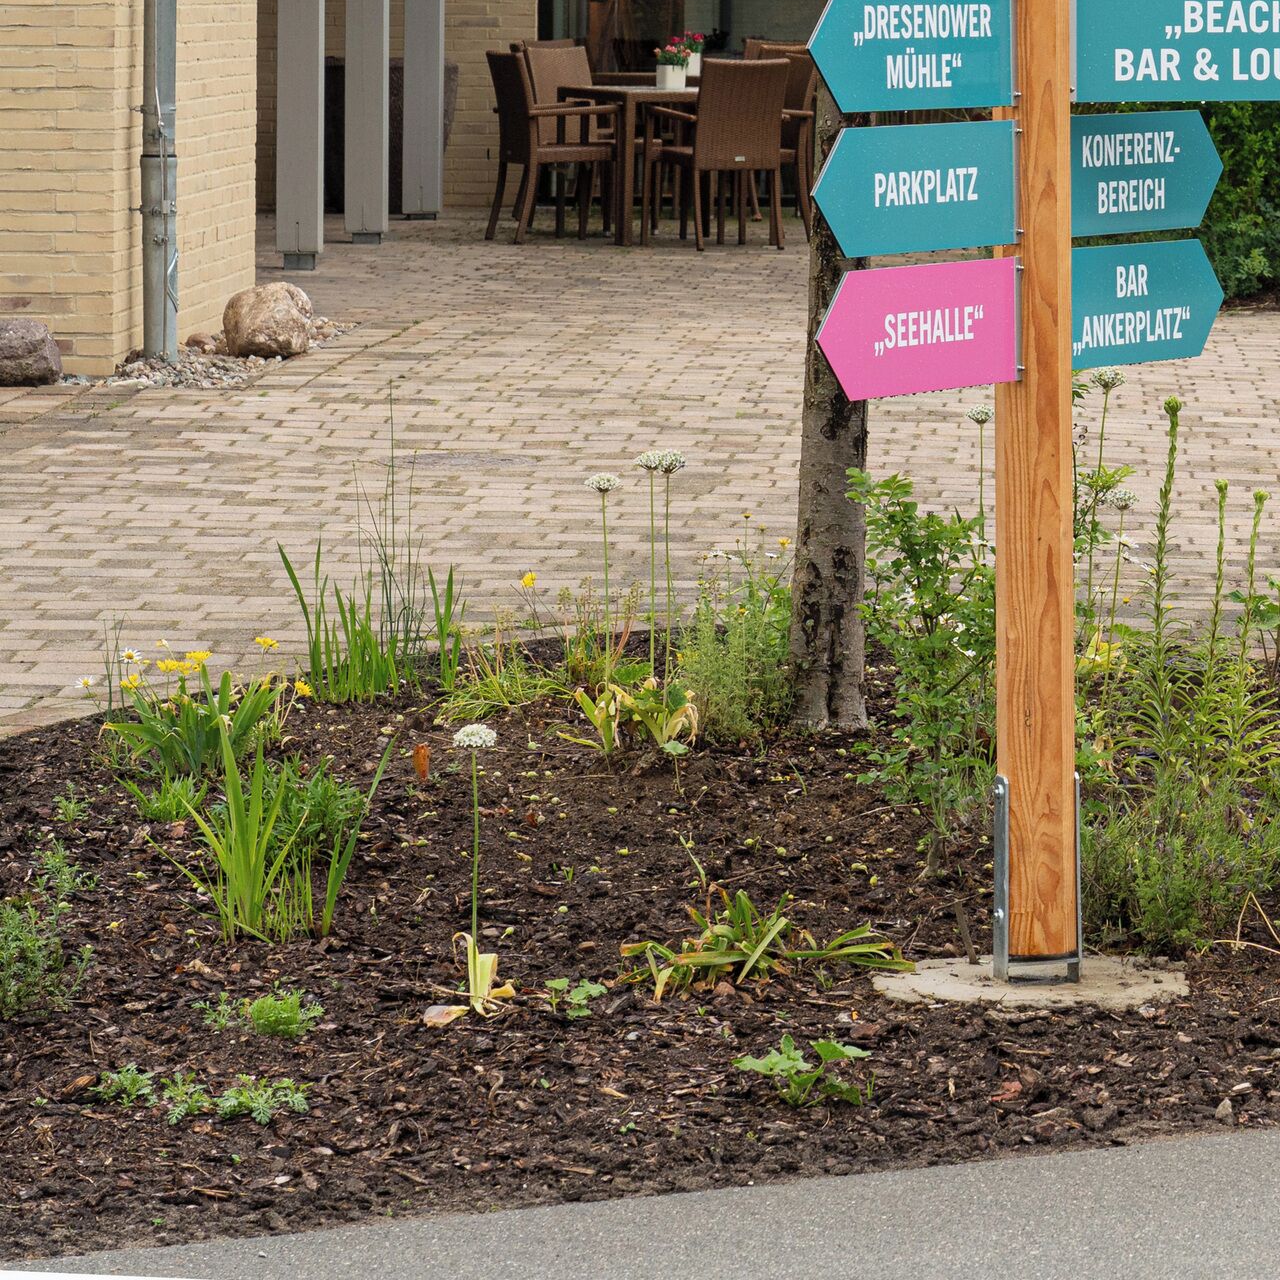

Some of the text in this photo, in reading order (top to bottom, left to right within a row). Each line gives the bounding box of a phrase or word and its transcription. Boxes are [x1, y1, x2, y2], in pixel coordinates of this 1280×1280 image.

[853, 3, 992, 47] „DRESENOWER
[886, 47, 962, 90] MÜHLE“
[1114, 48, 1181, 82] BAR
[1193, 47, 1220, 81] &
[1082, 130, 1181, 168] KONFERENZ-
[874, 166, 979, 208] PARKPLATZ
[1097, 177, 1165, 214] BEREICH
[1116, 264, 1149, 298] BAR
[874, 304, 984, 357] „SEEHALLE“
[1072, 305, 1191, 356] „ANKERPLATZ“
